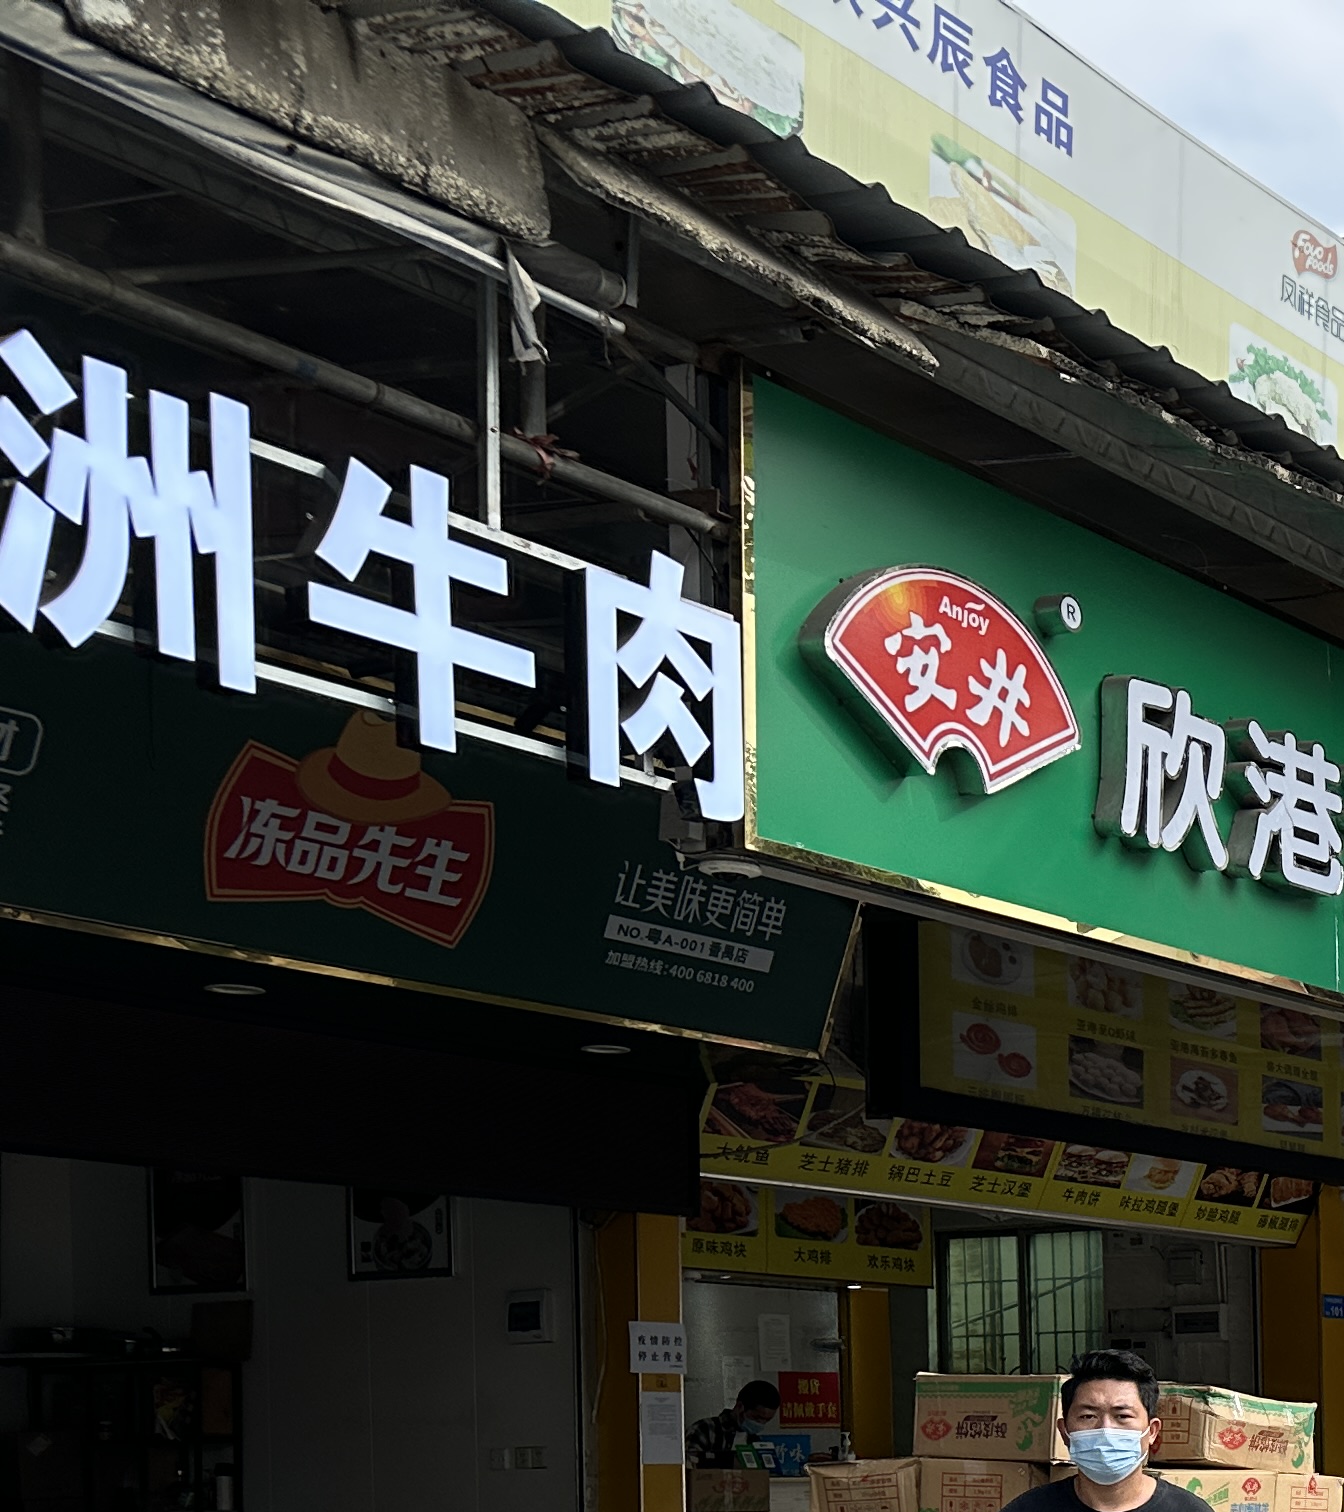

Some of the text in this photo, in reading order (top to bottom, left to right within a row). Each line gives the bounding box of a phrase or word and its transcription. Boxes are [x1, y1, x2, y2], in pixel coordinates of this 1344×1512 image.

[0, 328, 744, 822] 洲牛肉
[938, 594, 992, 638] Anjoy
[884, 611, 1032, 748] 安井
[223, 794, 471, 909] 冻品先生
[614, 859, 787, 942] 让美味更简单
[695, 969, 729, 988] 6818
[730, 976, 755, 993] 400
[712, 1143, 770, 1166] 大鱿鱼
[798, 1152, 870, 1177] 芝士猪排
[888, 1164, 956, 1188] 锅巴土豆
[969, 1175, 1032, 1198] 芝士汉堡
[1062, 1187, 1101, 1208] 牛肉饼
[691, 1238, 747, 1259] 原味鸡块
[793, 1247, 833, 1266] 大鸡排
[866, 1253, 916, 1273] 欢乐鸡块
[637, 1334, 683, 1347] 疫情防控
[638, 1351, 684, 1362] 停止营业
